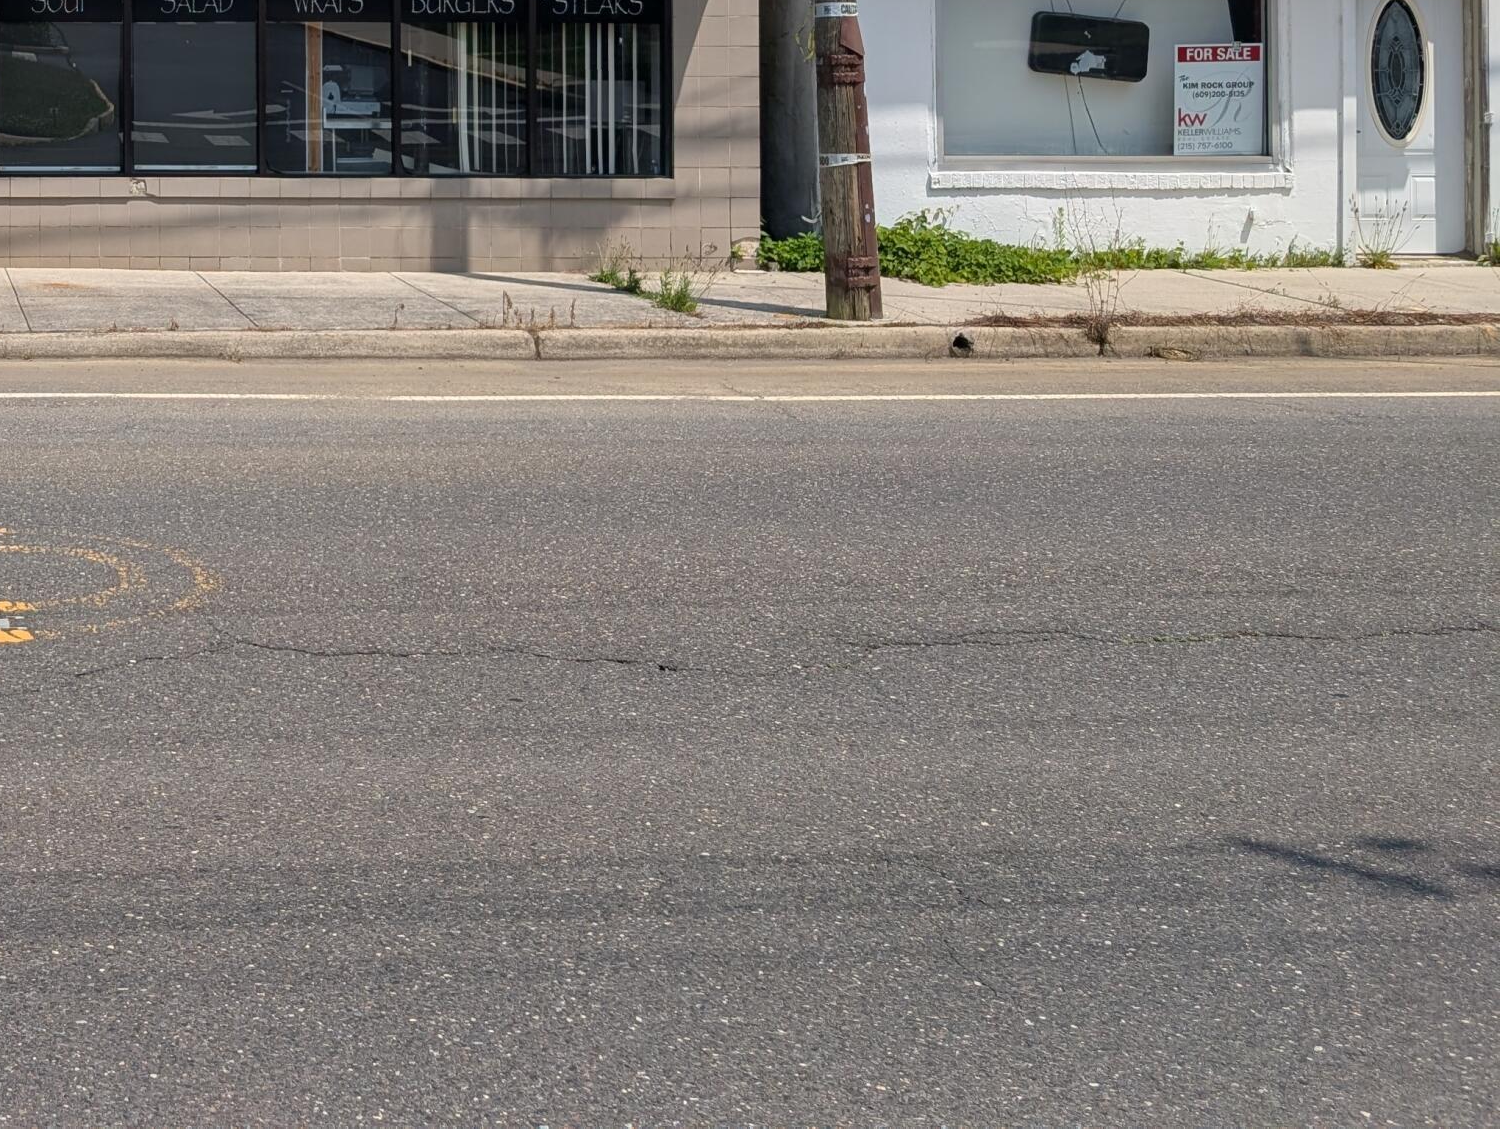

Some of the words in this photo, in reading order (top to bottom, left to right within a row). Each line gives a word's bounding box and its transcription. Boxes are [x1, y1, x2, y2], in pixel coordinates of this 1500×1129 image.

[1186, 48, 1213, 61] FOR
[1216, 48, 1251, 60] SALE
[1200, 81, 1224, 89] ROCK
[1225, 80, 1255, 89] GROUP
[1178, 108, 1207, 127] kw
[1177, 142, 1195, 150] (215)
[1197, 141, 1233, 150] 757-6100
